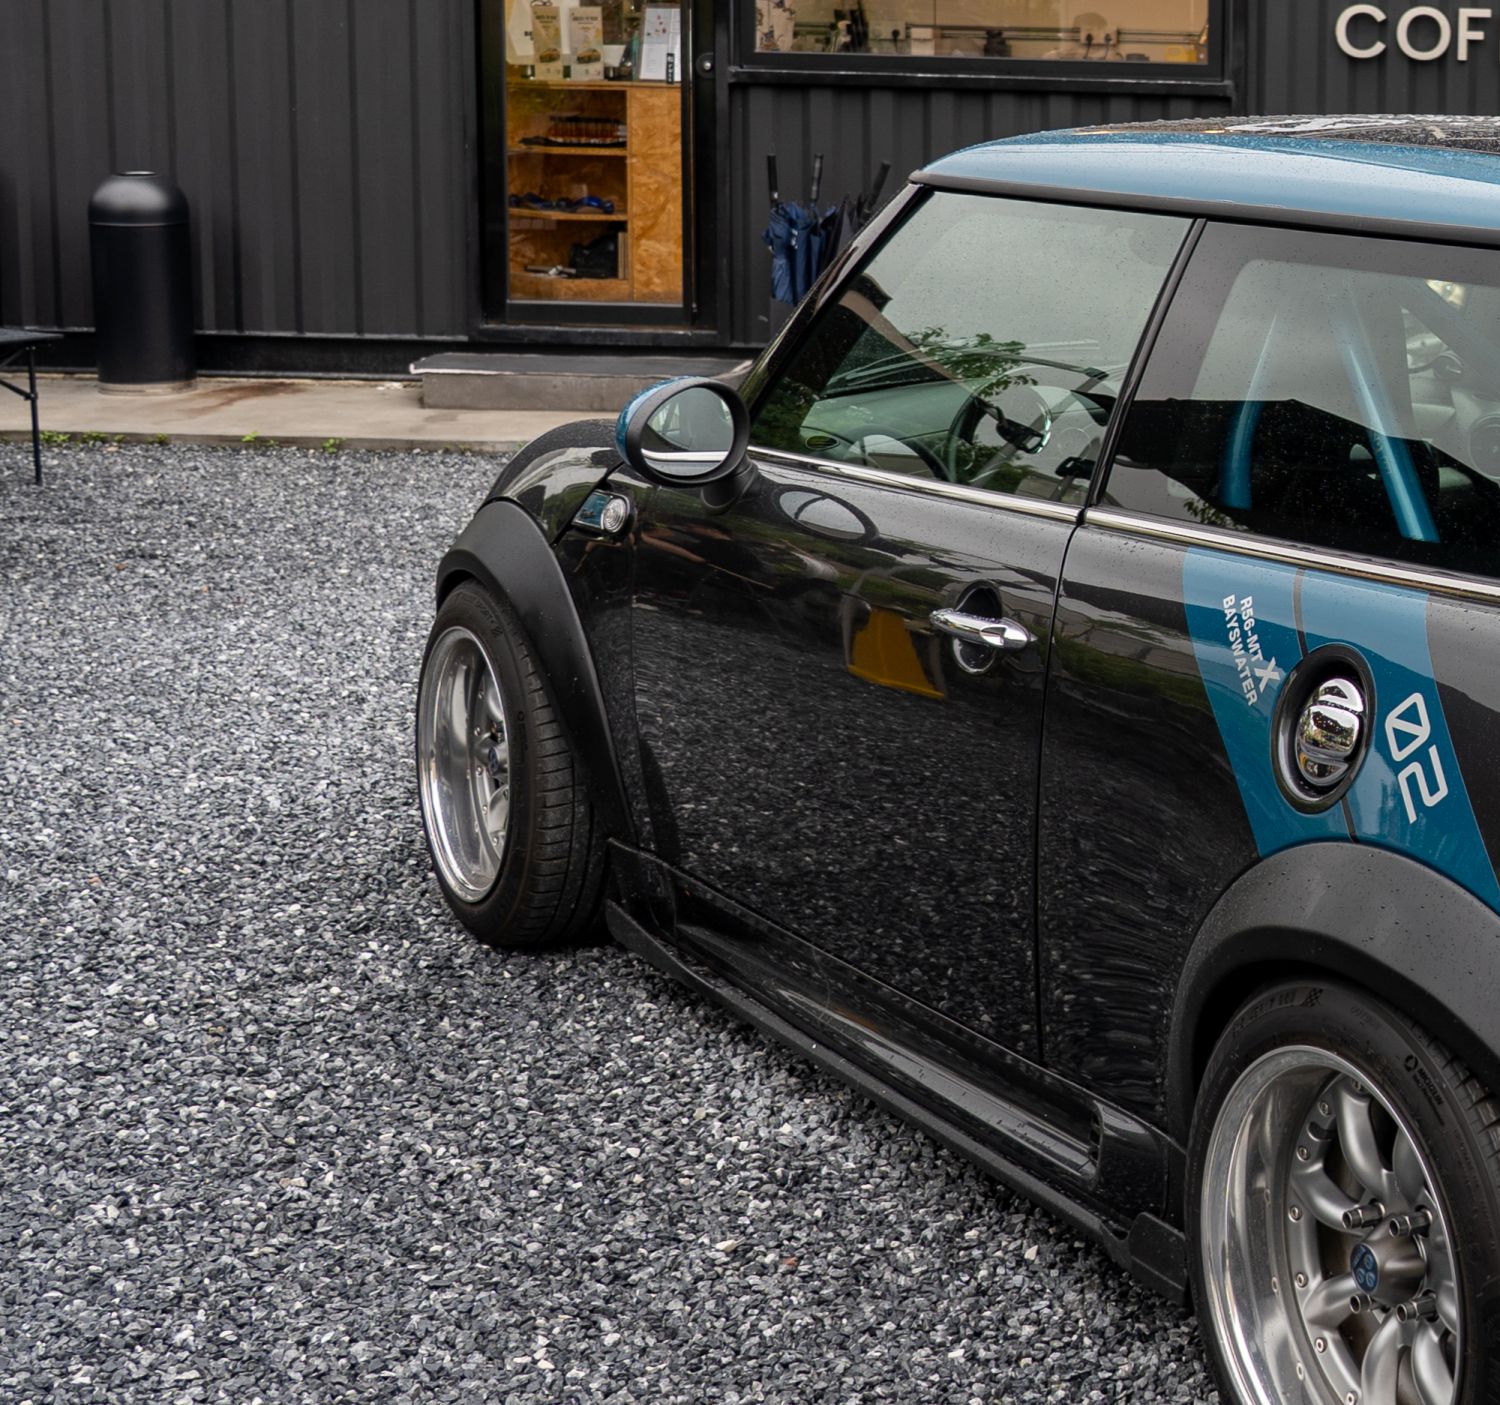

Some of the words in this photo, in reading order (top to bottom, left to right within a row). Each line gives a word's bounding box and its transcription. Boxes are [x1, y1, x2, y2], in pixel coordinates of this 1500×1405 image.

[1223, 594, 1258, 706] BAYSWATER
[1240, 596, 1263, 662] R56-MT
[1385, 692, 1449, 824] 02
